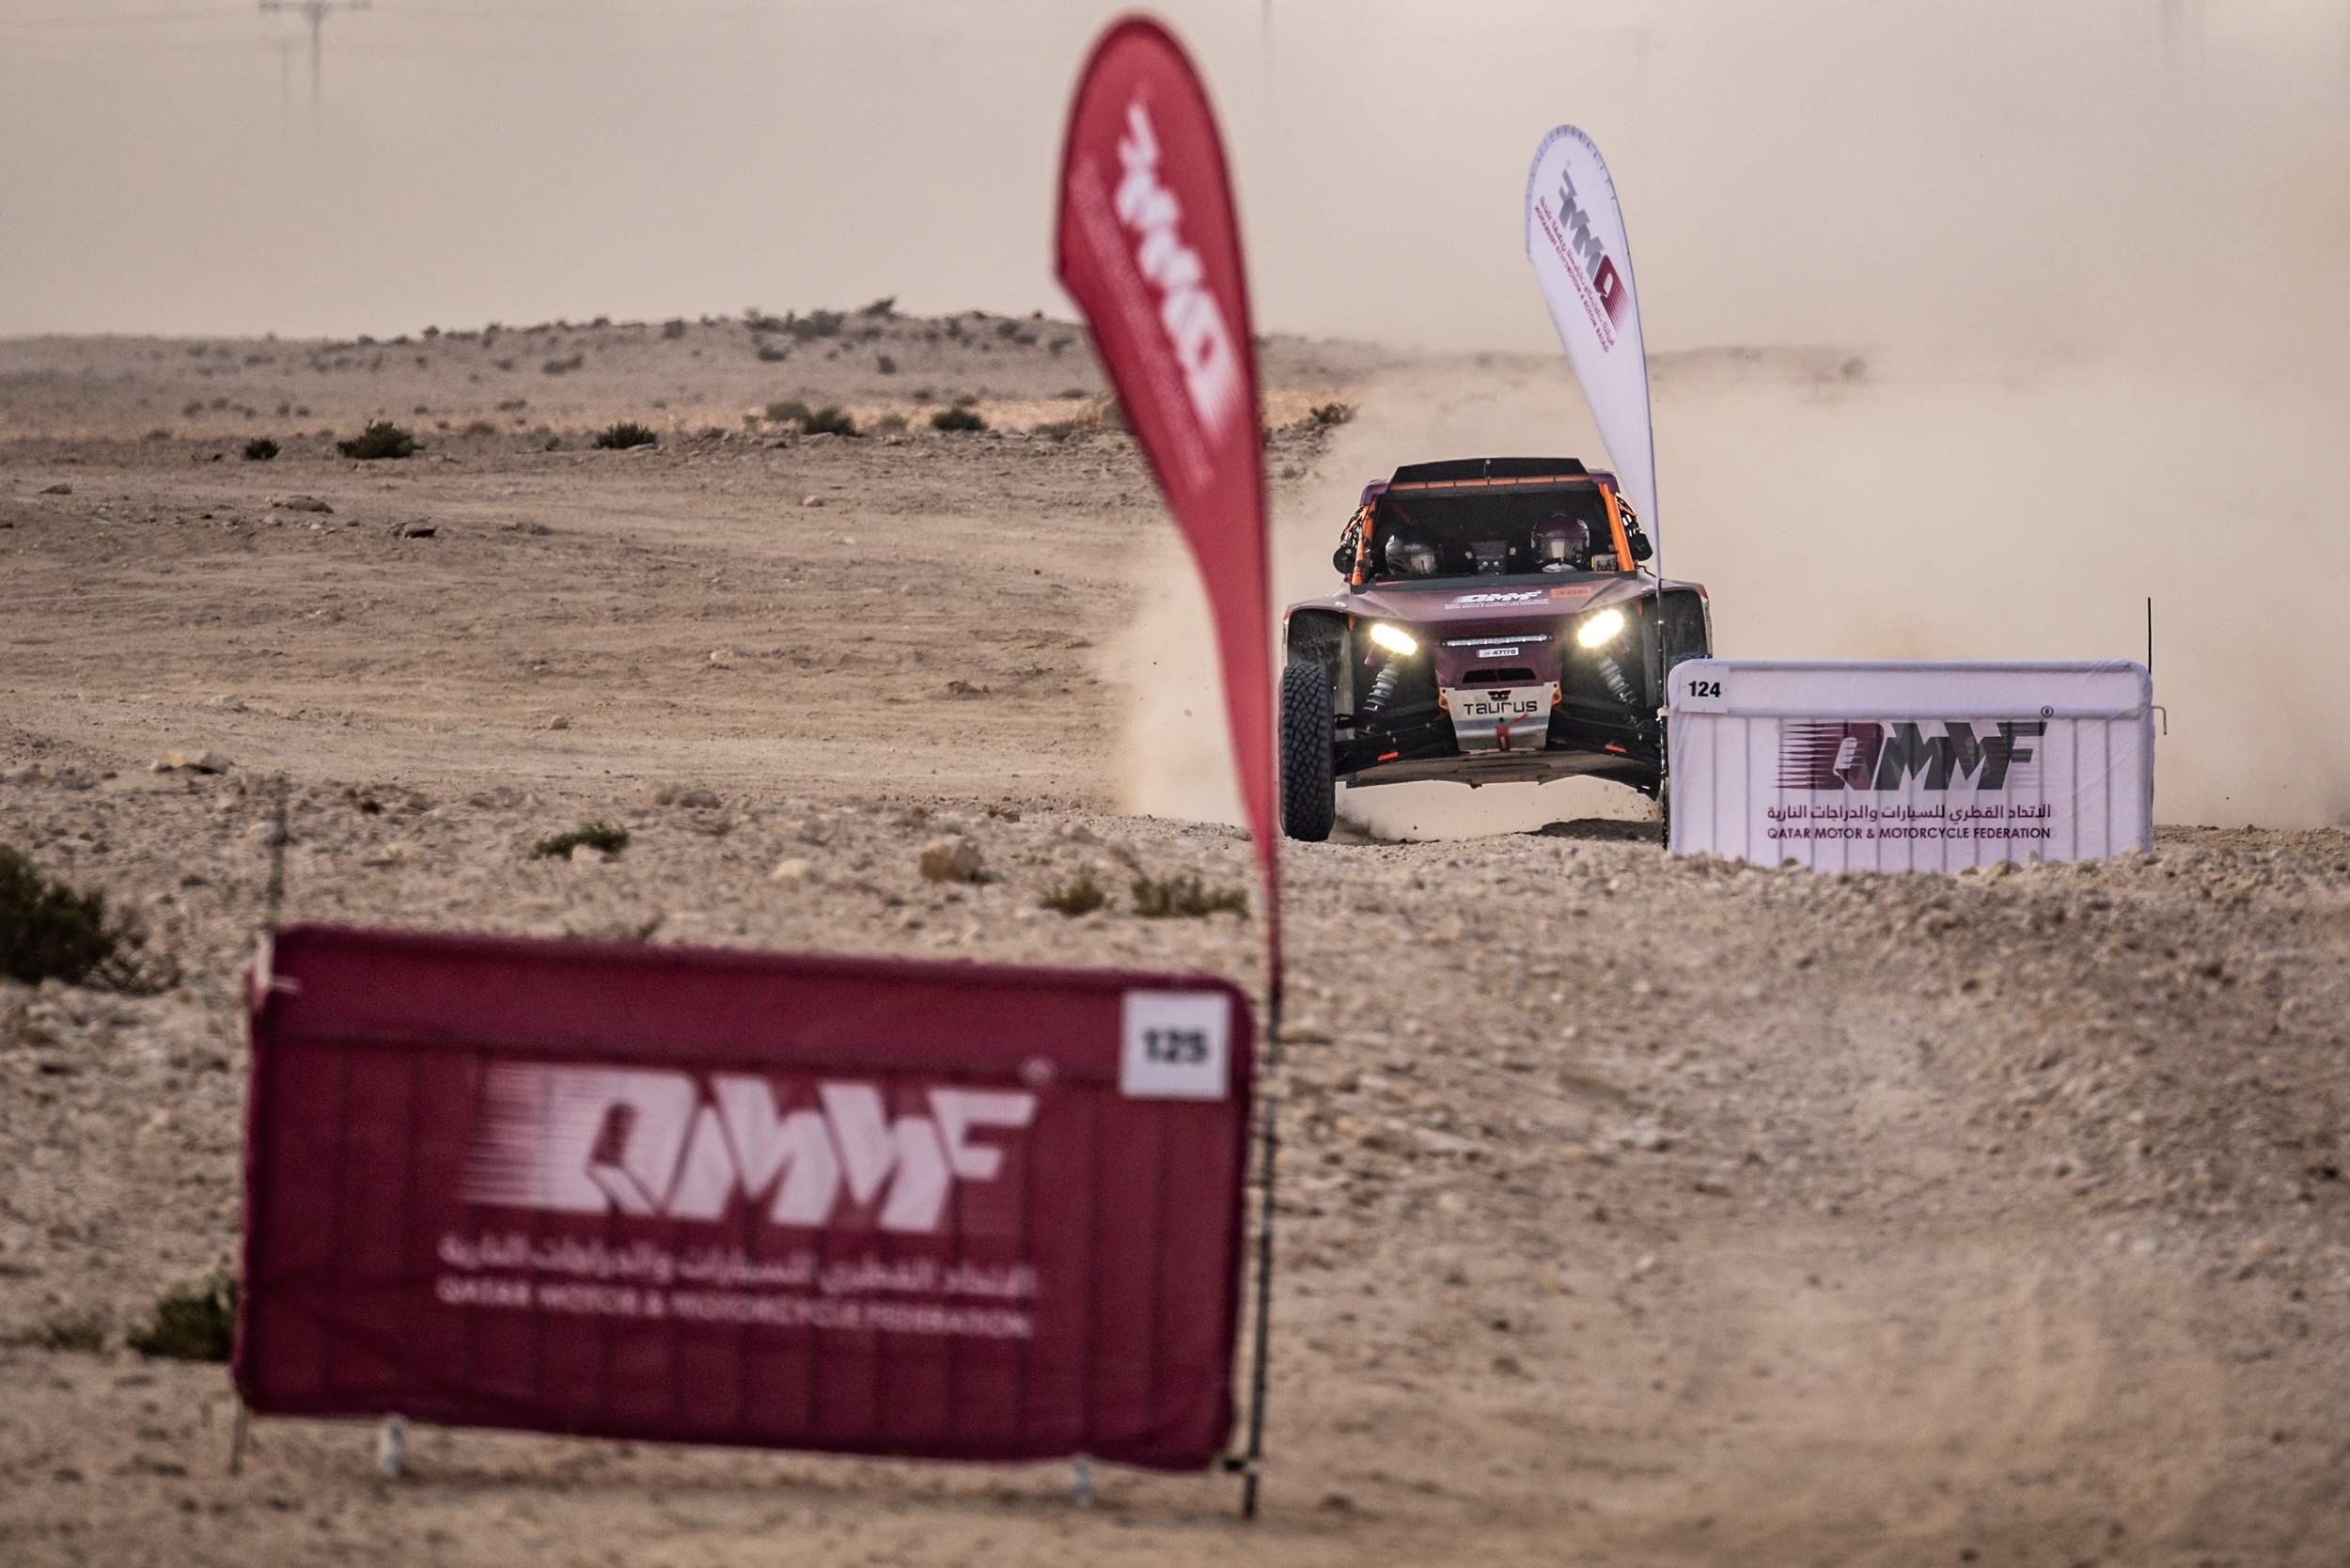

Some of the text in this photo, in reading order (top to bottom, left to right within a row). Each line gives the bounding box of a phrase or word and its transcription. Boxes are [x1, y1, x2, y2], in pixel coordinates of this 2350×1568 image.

[1688, 682, 1721, 698] 124
[1769, 721, 2048, 791] QMMF
[1767, 805, 2051, 824] الاتحاد القطري للسيارات والدراجات النارية
[1767, 827, 2050, 839] QATAR MOTOR & MOTORCYCLE FEDERATION
[1144, 1027, 1207, 1065] 125
[460, 1060, 1039, 1232] QMMF
